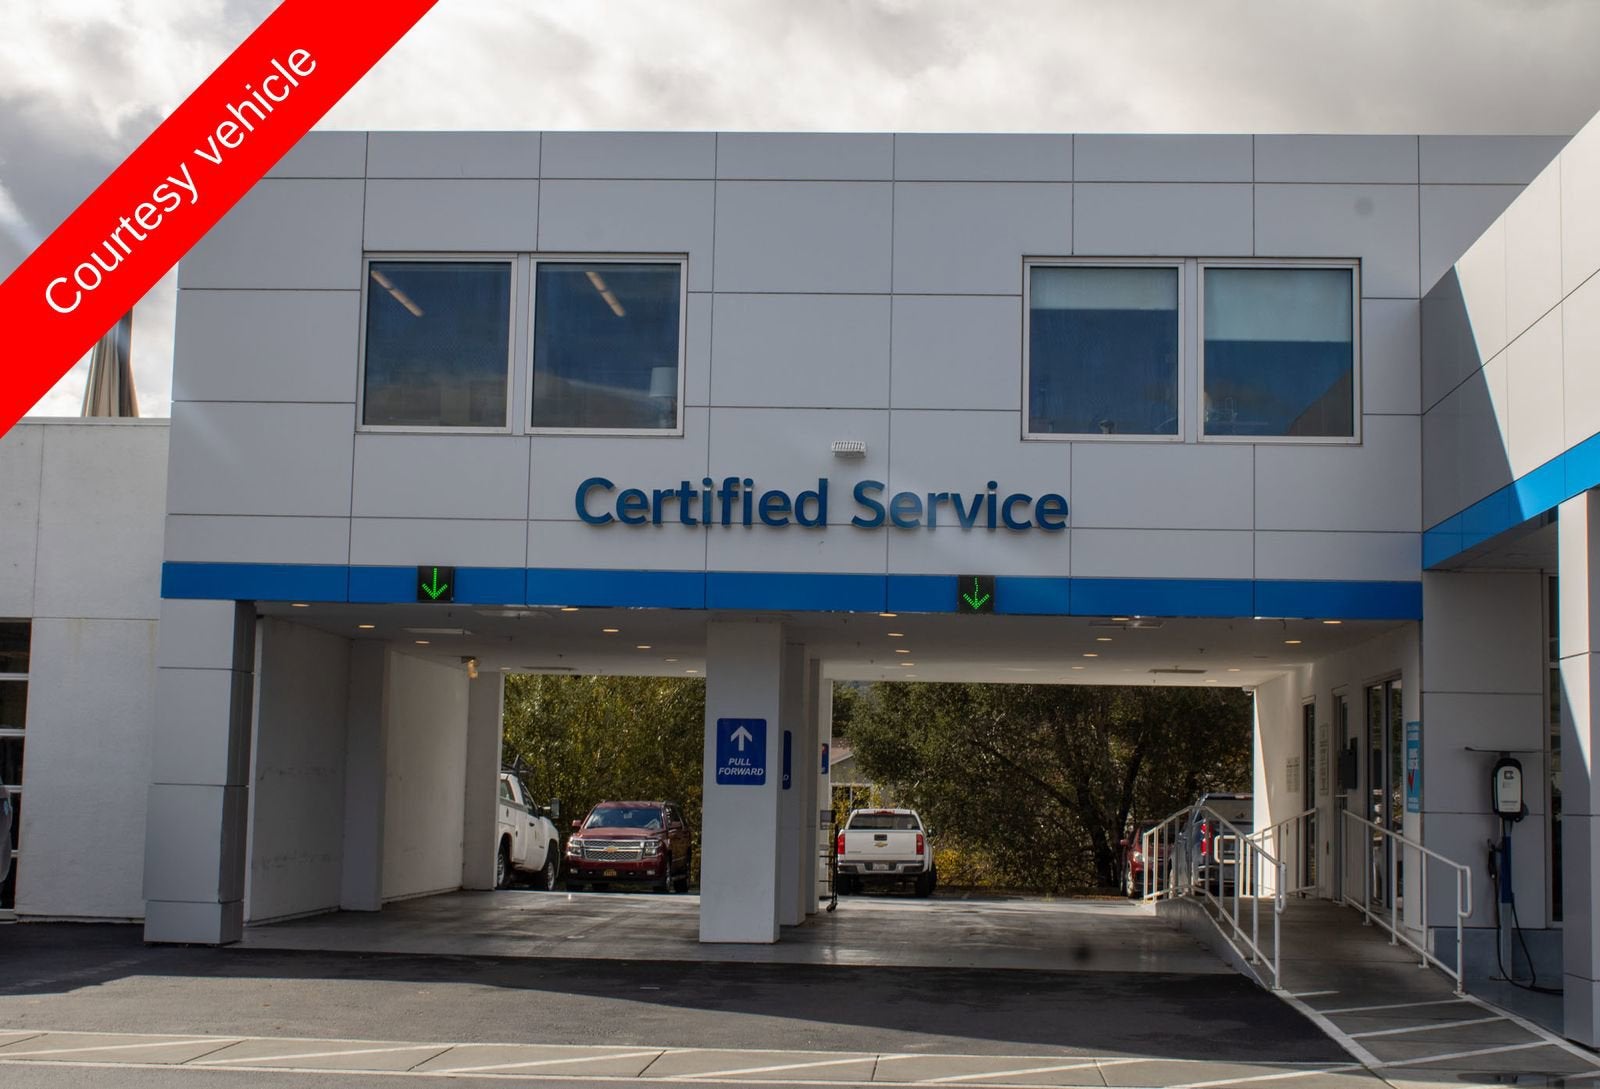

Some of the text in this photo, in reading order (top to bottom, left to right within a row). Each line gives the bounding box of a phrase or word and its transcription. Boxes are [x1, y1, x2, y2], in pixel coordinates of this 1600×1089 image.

[574, 476, 1071, 531] Certified Service
[728, 757, 752, 766] PULL
[718, 767, 764, 776] FORWARD
